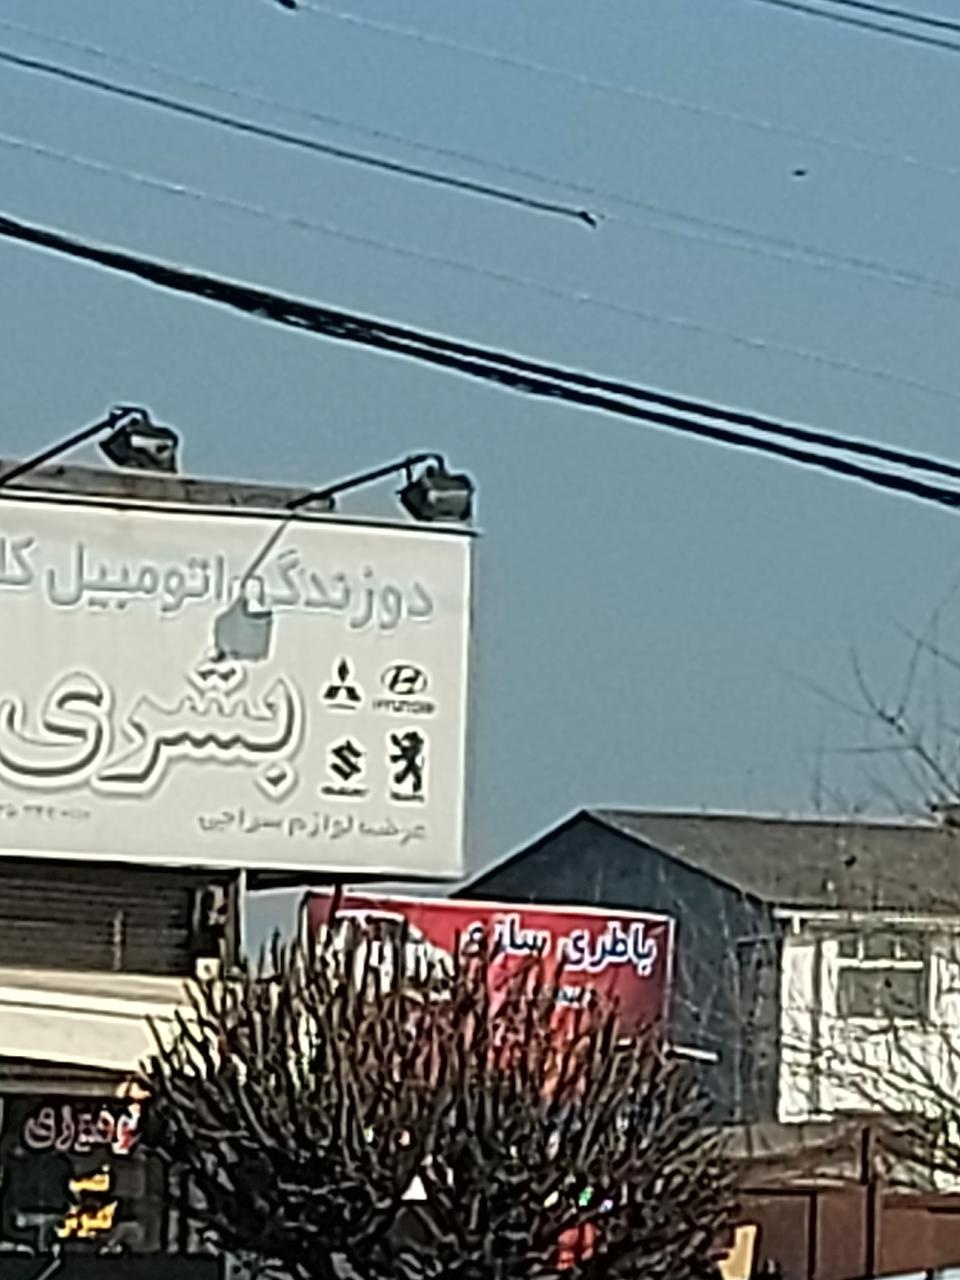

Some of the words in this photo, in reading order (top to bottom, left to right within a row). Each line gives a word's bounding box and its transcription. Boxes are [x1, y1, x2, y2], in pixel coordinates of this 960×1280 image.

[46, 540, 224, 614] اتومبیل
[288, 811, 355, 841] لوازم
[556, 920, 658, 977] باطری
